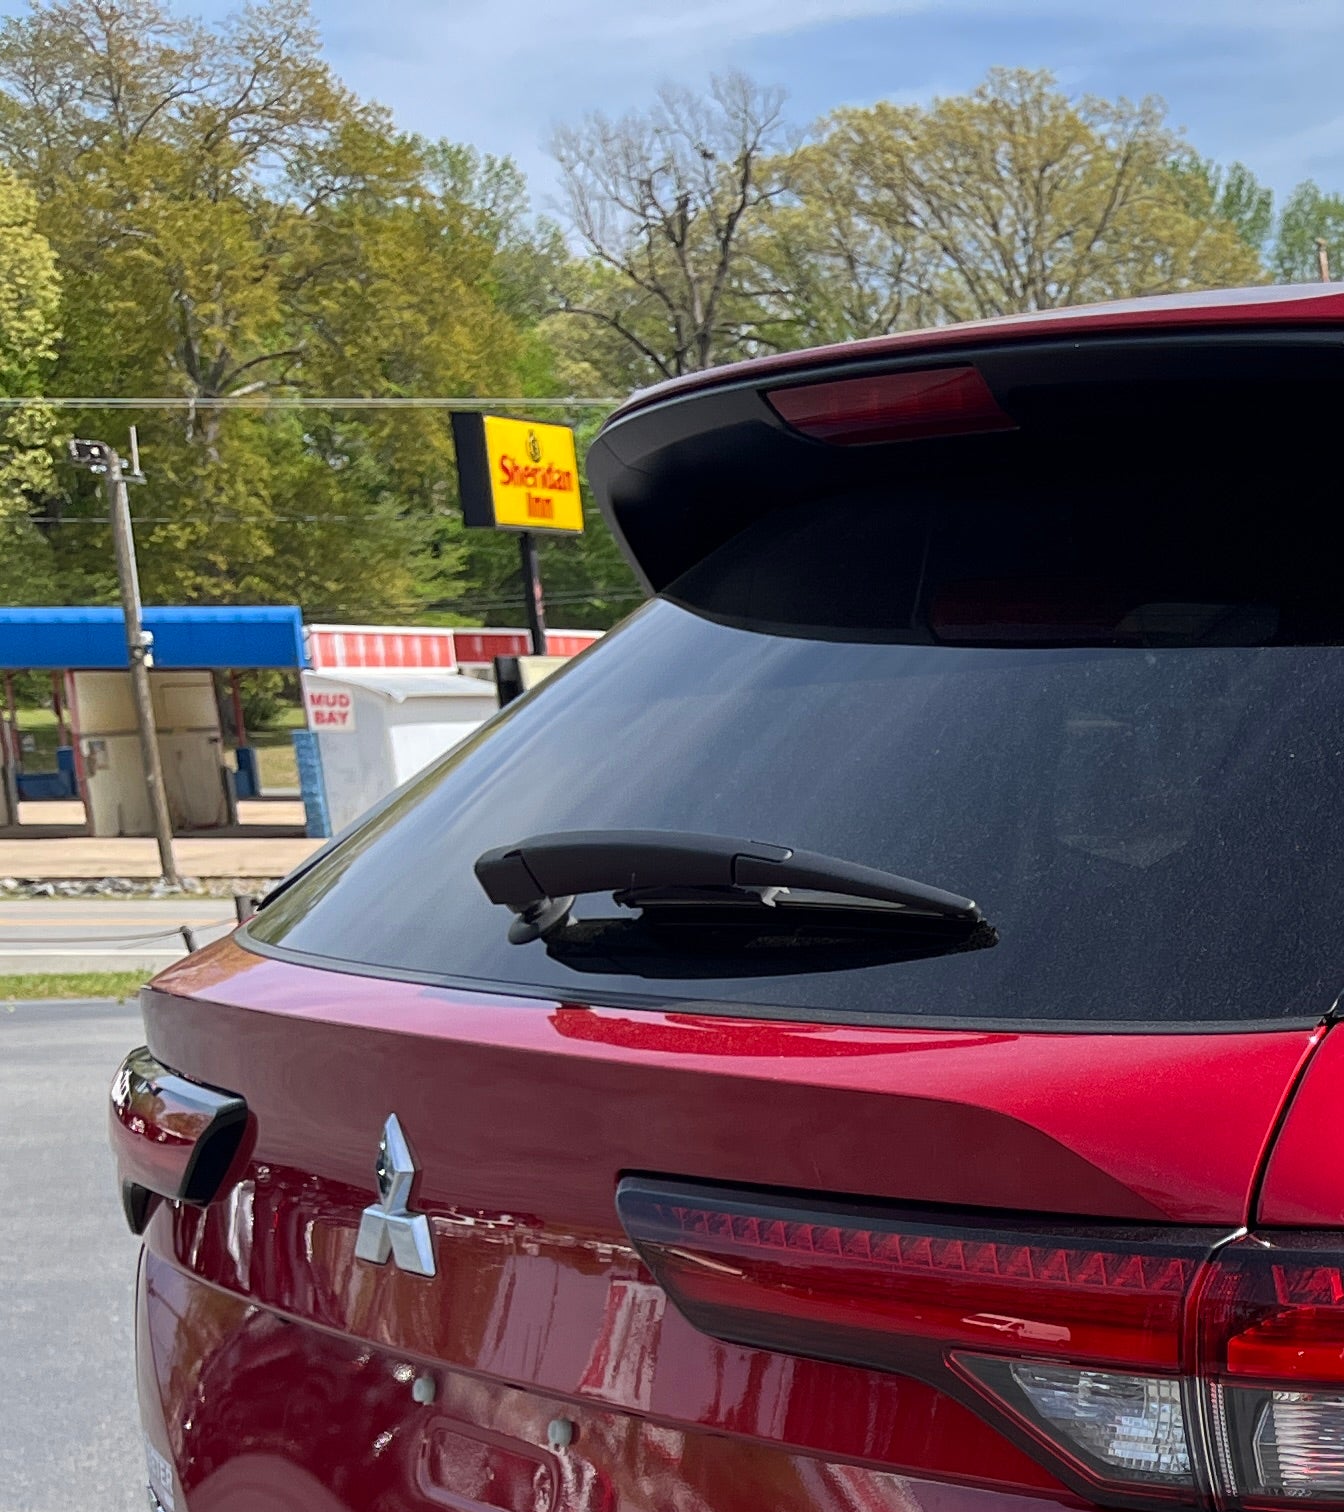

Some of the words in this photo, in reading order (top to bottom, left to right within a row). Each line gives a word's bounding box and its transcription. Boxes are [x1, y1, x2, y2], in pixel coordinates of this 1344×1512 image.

[500, 454, 572, 492] Sheridan
[527, 493, 553, 518] Inn
[310, 692, 350, 707] MUD
[314, 711, 348, 725] BAY
